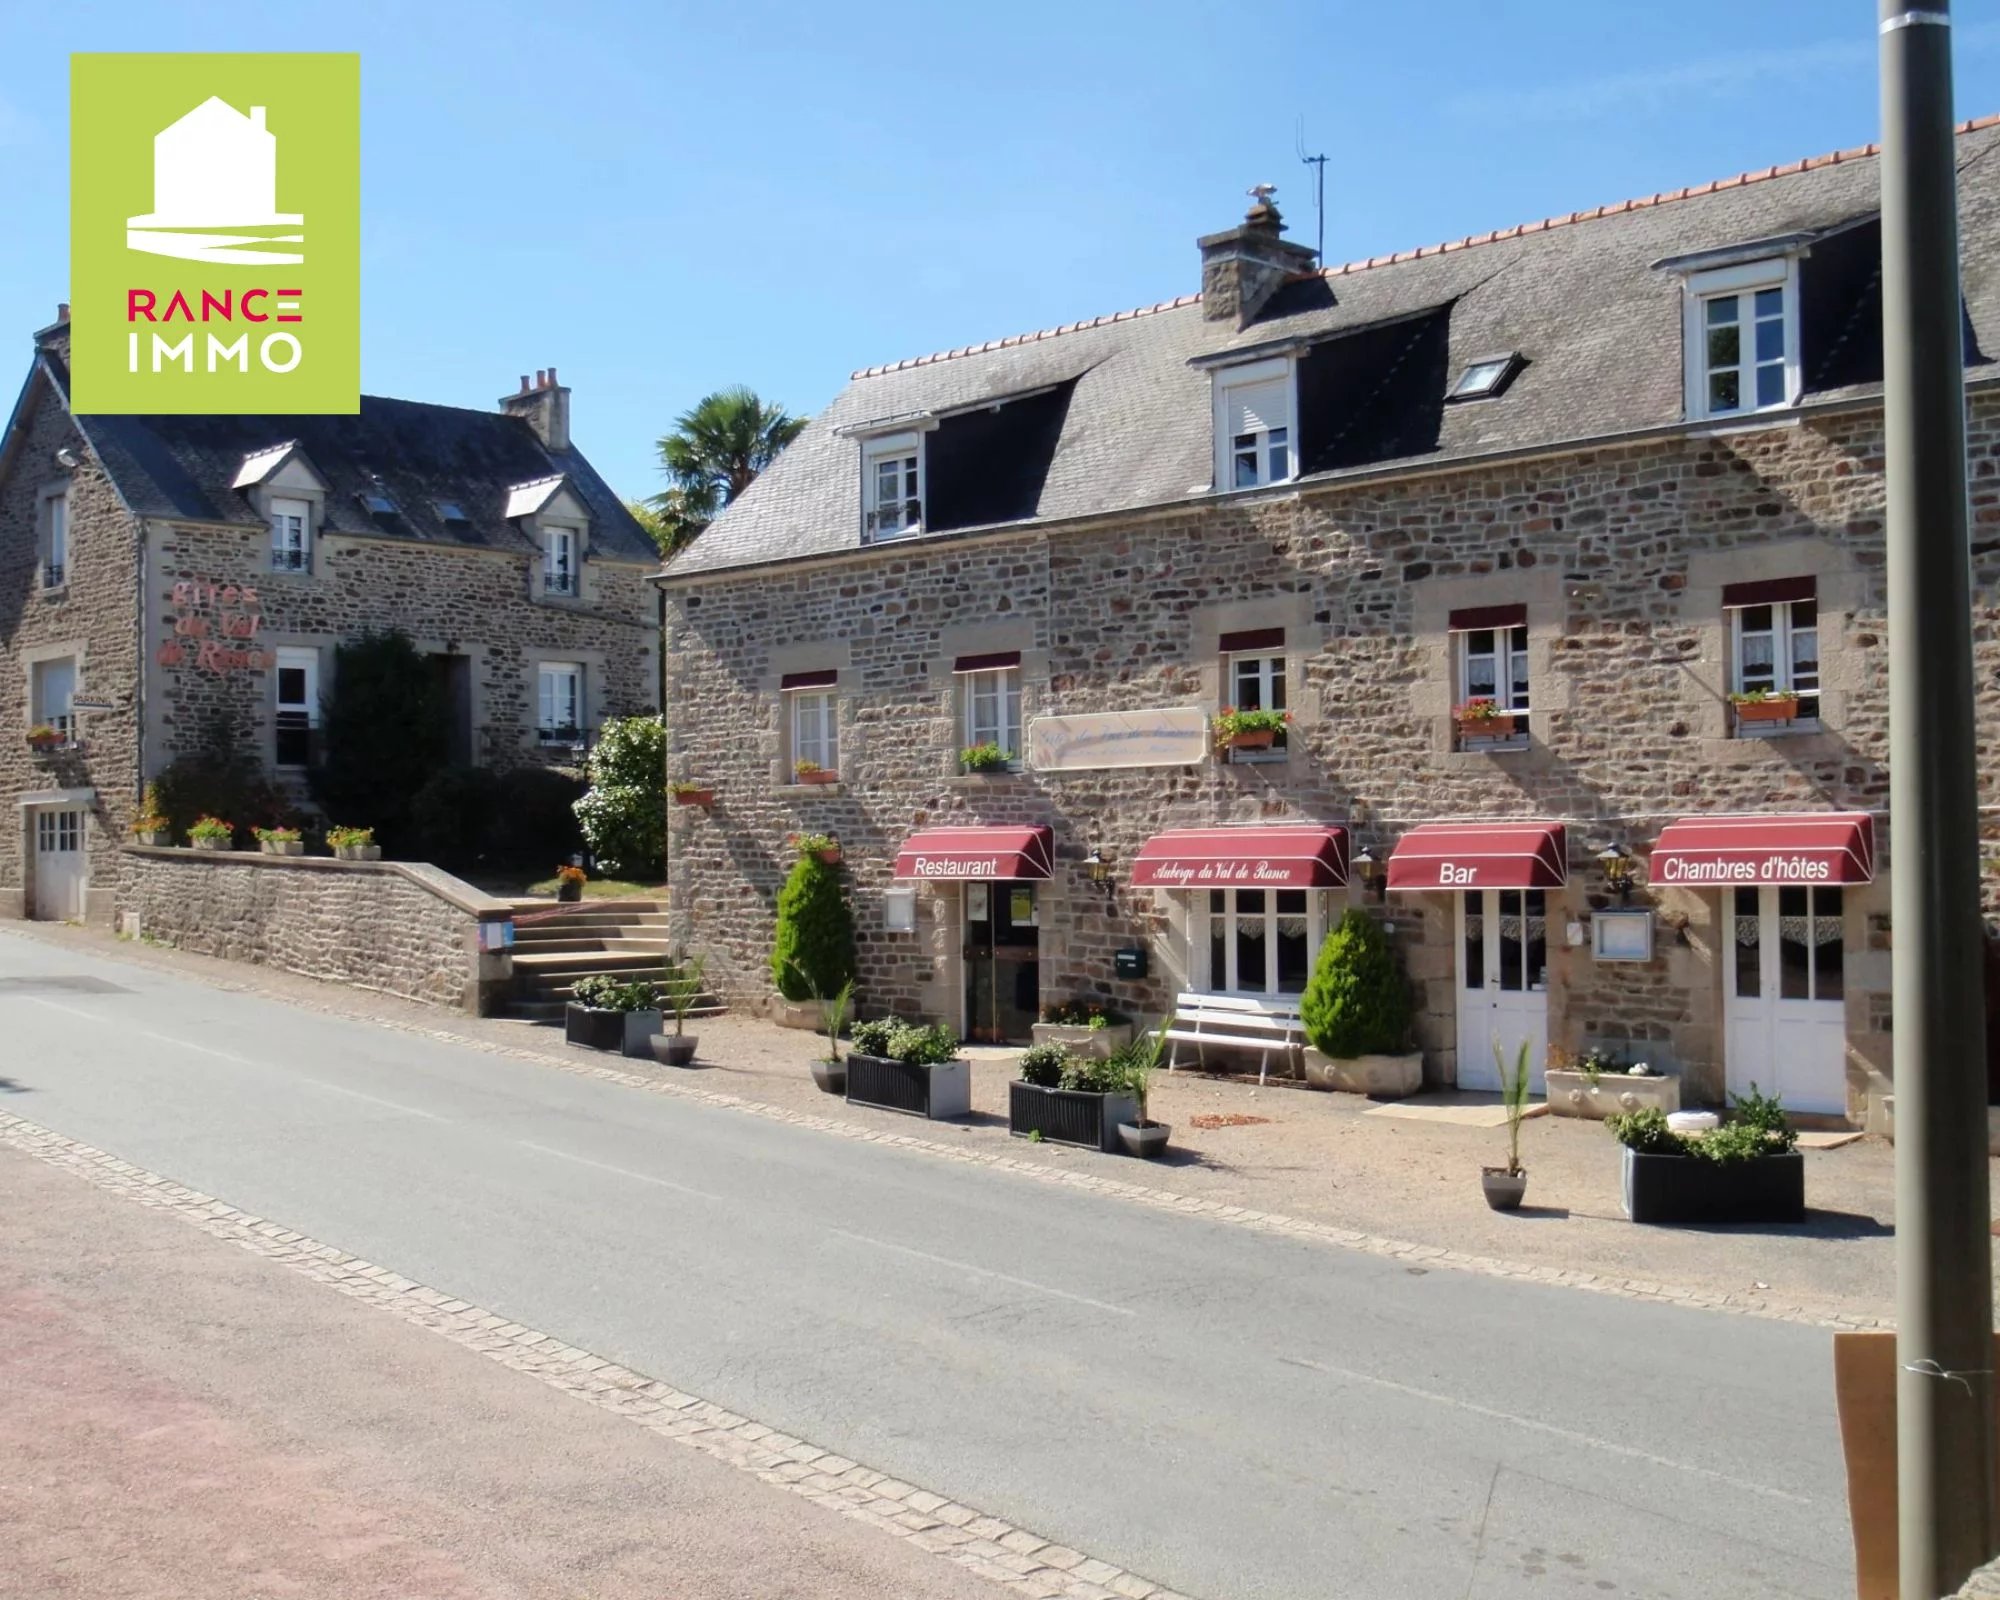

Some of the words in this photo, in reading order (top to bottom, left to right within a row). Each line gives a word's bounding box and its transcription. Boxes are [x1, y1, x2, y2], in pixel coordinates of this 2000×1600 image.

[913, 857, 997, 876] Restaurant
[1153, 861, 1195, 885] Auberge
[1198, 863, 1212, 879] du
[1214, 861, 1234, 880] Val
[1235, 862, 1249, 880] de
[1253, 860, 1290, 880] Rance
[1439, 862, 1478, 884] Bar
[1663, 857, 1756, 880] Chambres
[1760, 856, 1829, 879] d'hôtes
